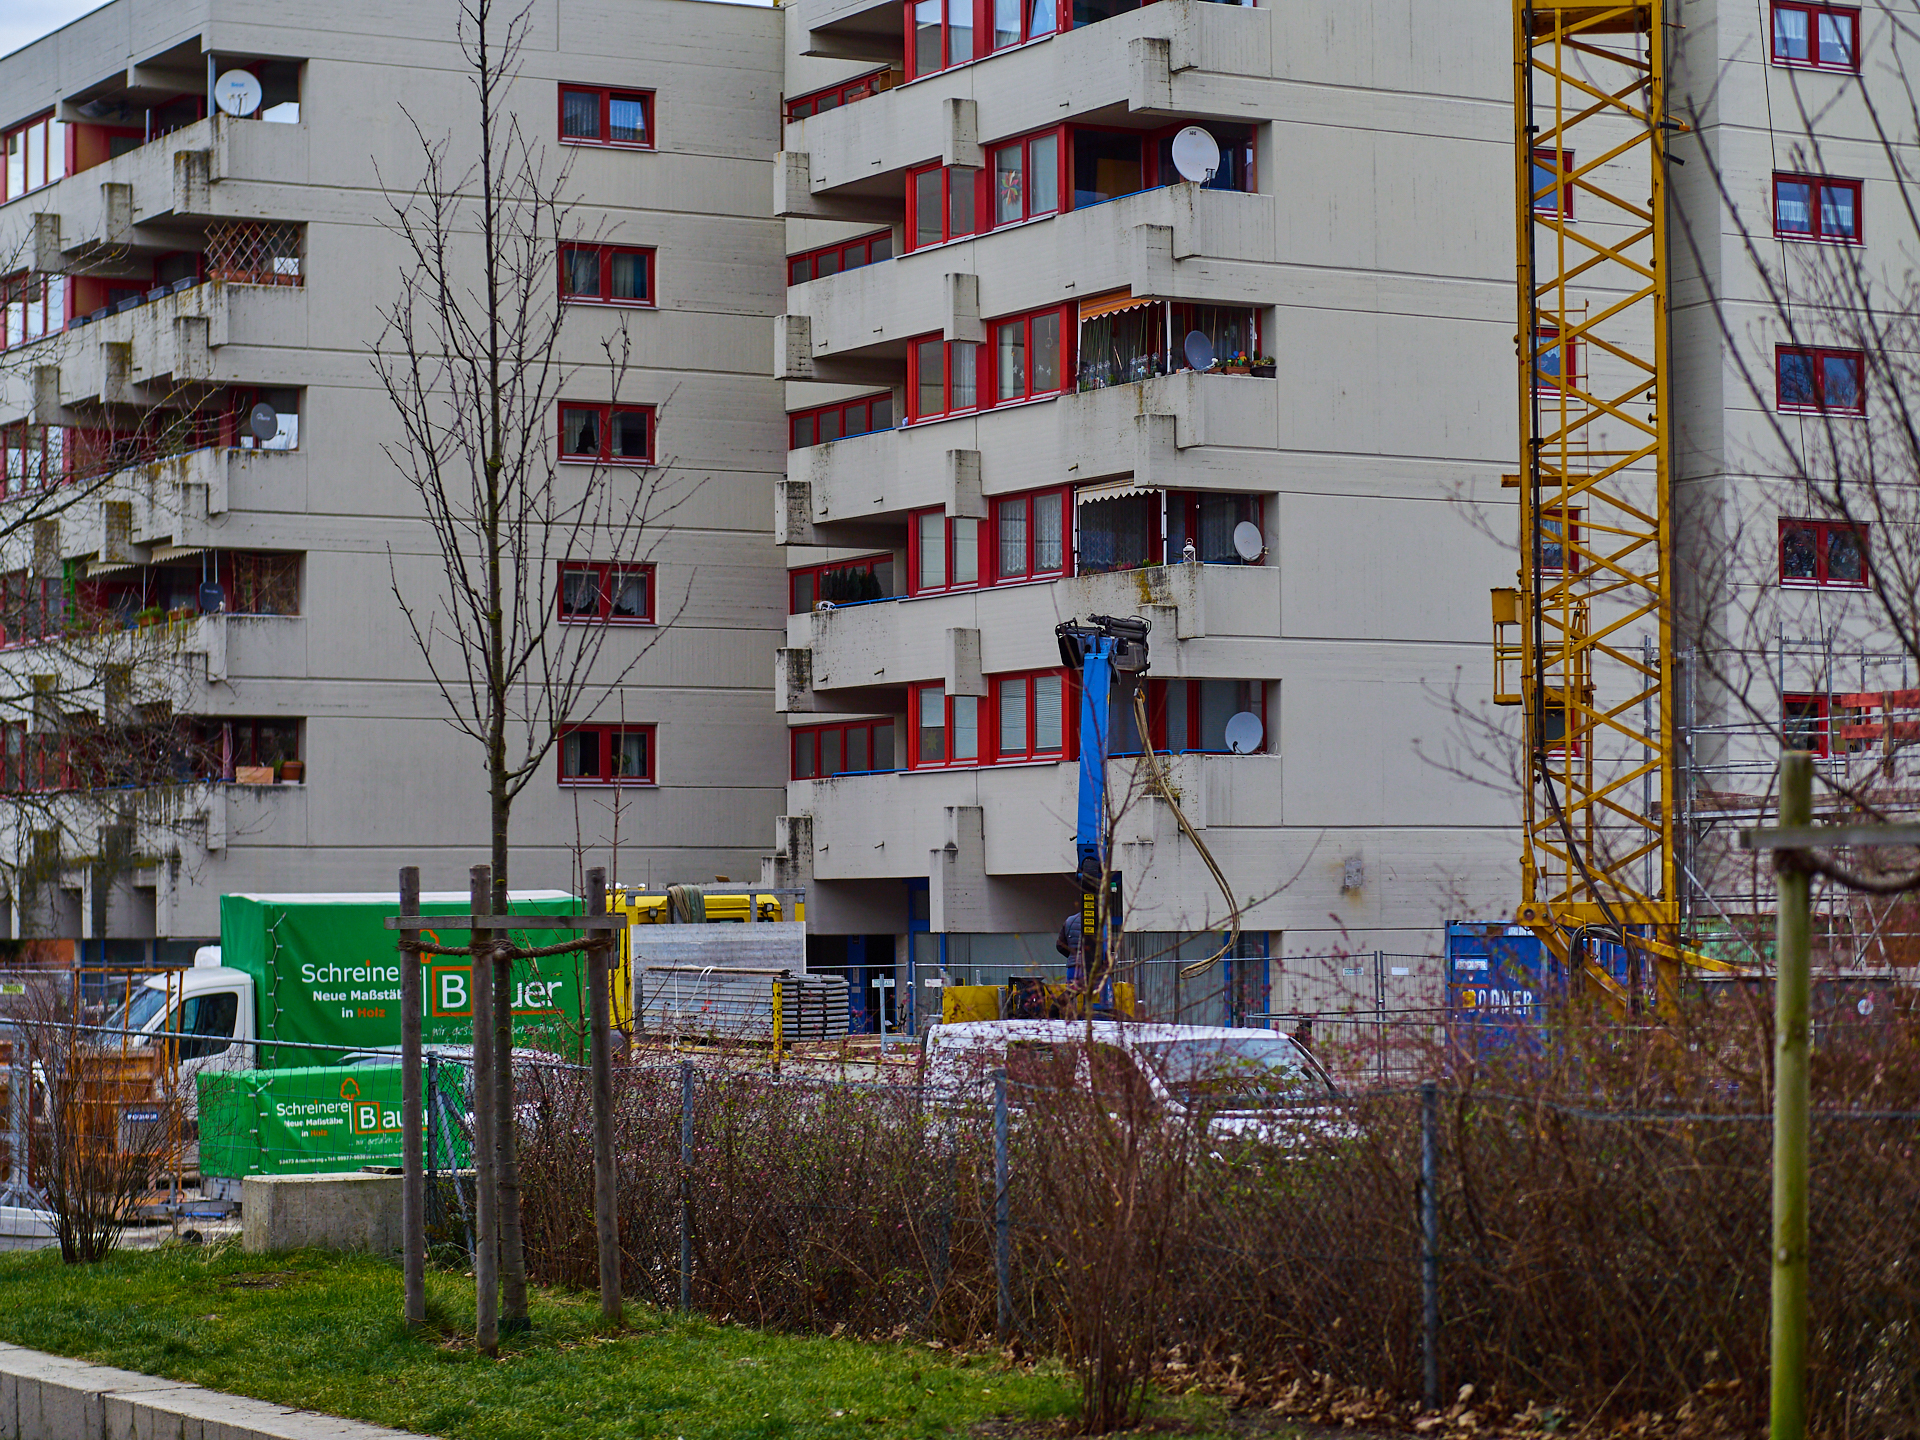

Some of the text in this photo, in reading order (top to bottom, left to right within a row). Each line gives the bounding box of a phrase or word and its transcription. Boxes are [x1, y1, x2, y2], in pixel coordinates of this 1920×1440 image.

[313, 989, 402, 1001] Neue Maßstäb
[442, 975, 562, 1008] Buer
[341, 1007, 386, 1018] in Holz
[284, 1119, 303, 1128] Neue
[311, 1129, 328, 1137] Holz
